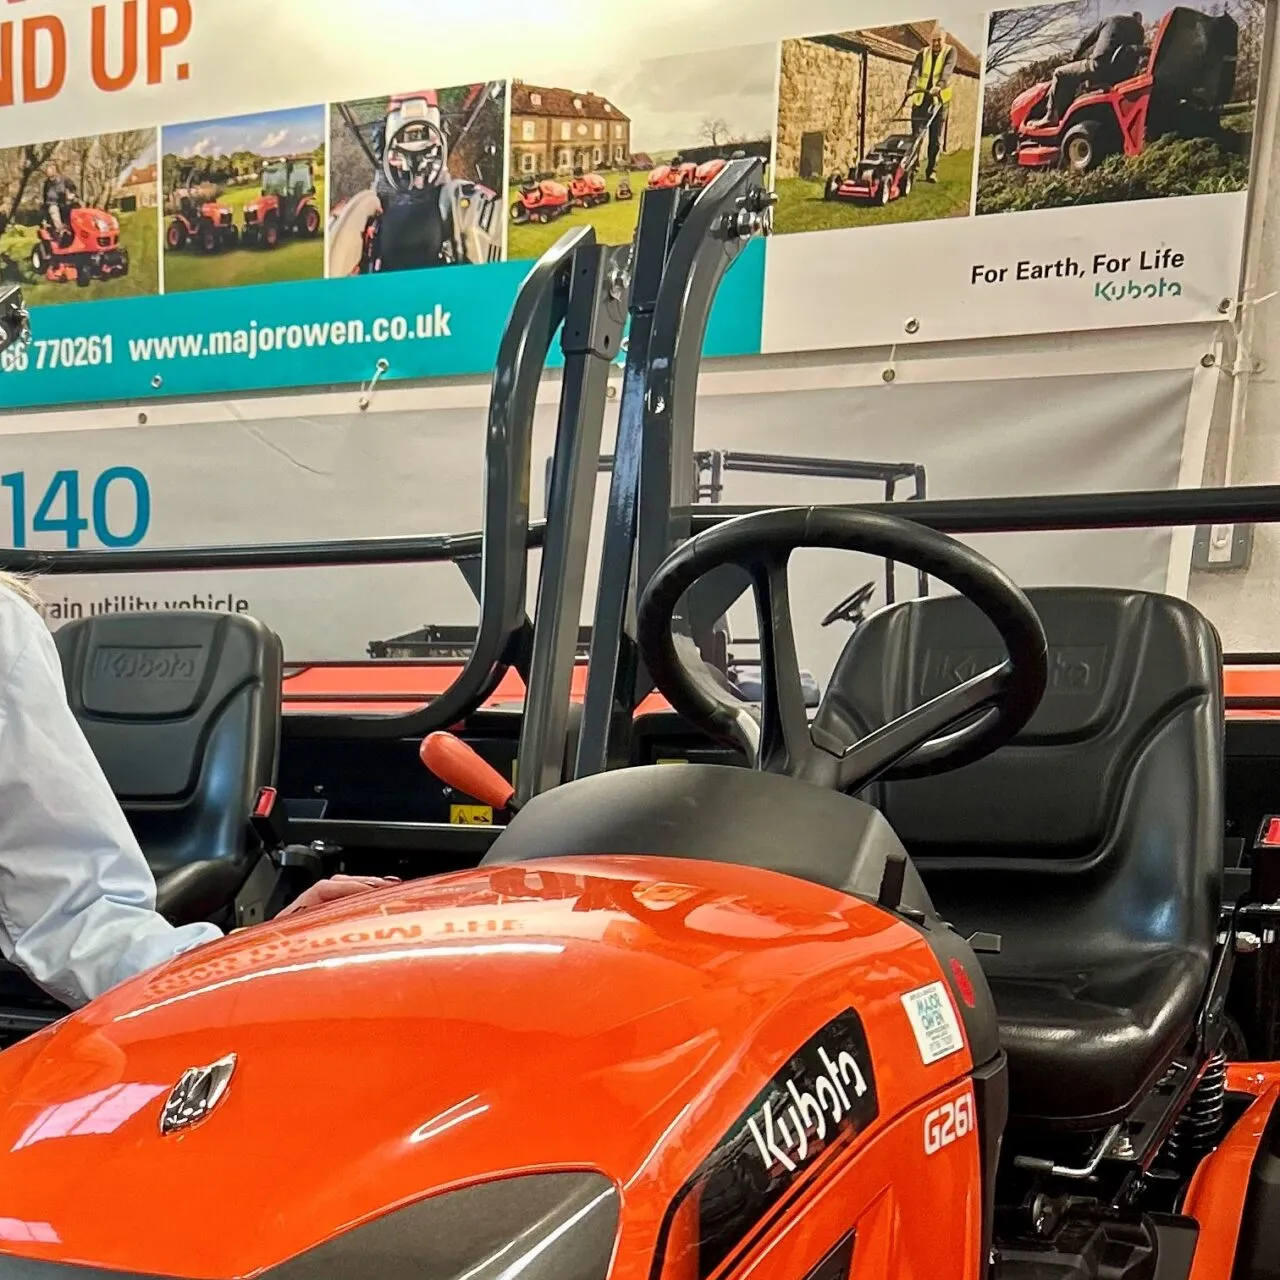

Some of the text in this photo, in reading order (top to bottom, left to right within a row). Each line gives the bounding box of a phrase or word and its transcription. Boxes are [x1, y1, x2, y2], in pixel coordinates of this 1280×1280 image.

[90, 0, 193, 92] UP.
[971, 248, 1185, 285] For Earth, For Life
[1094, 277, 1182, 302] Kubota
[34, 333, 113, 370] 770261
[128, 303, 452, 362] www.majorowen.co.uk
[747, 1046, 867, 1171] Kubota
[924, 1091, 975, 1157] G261
